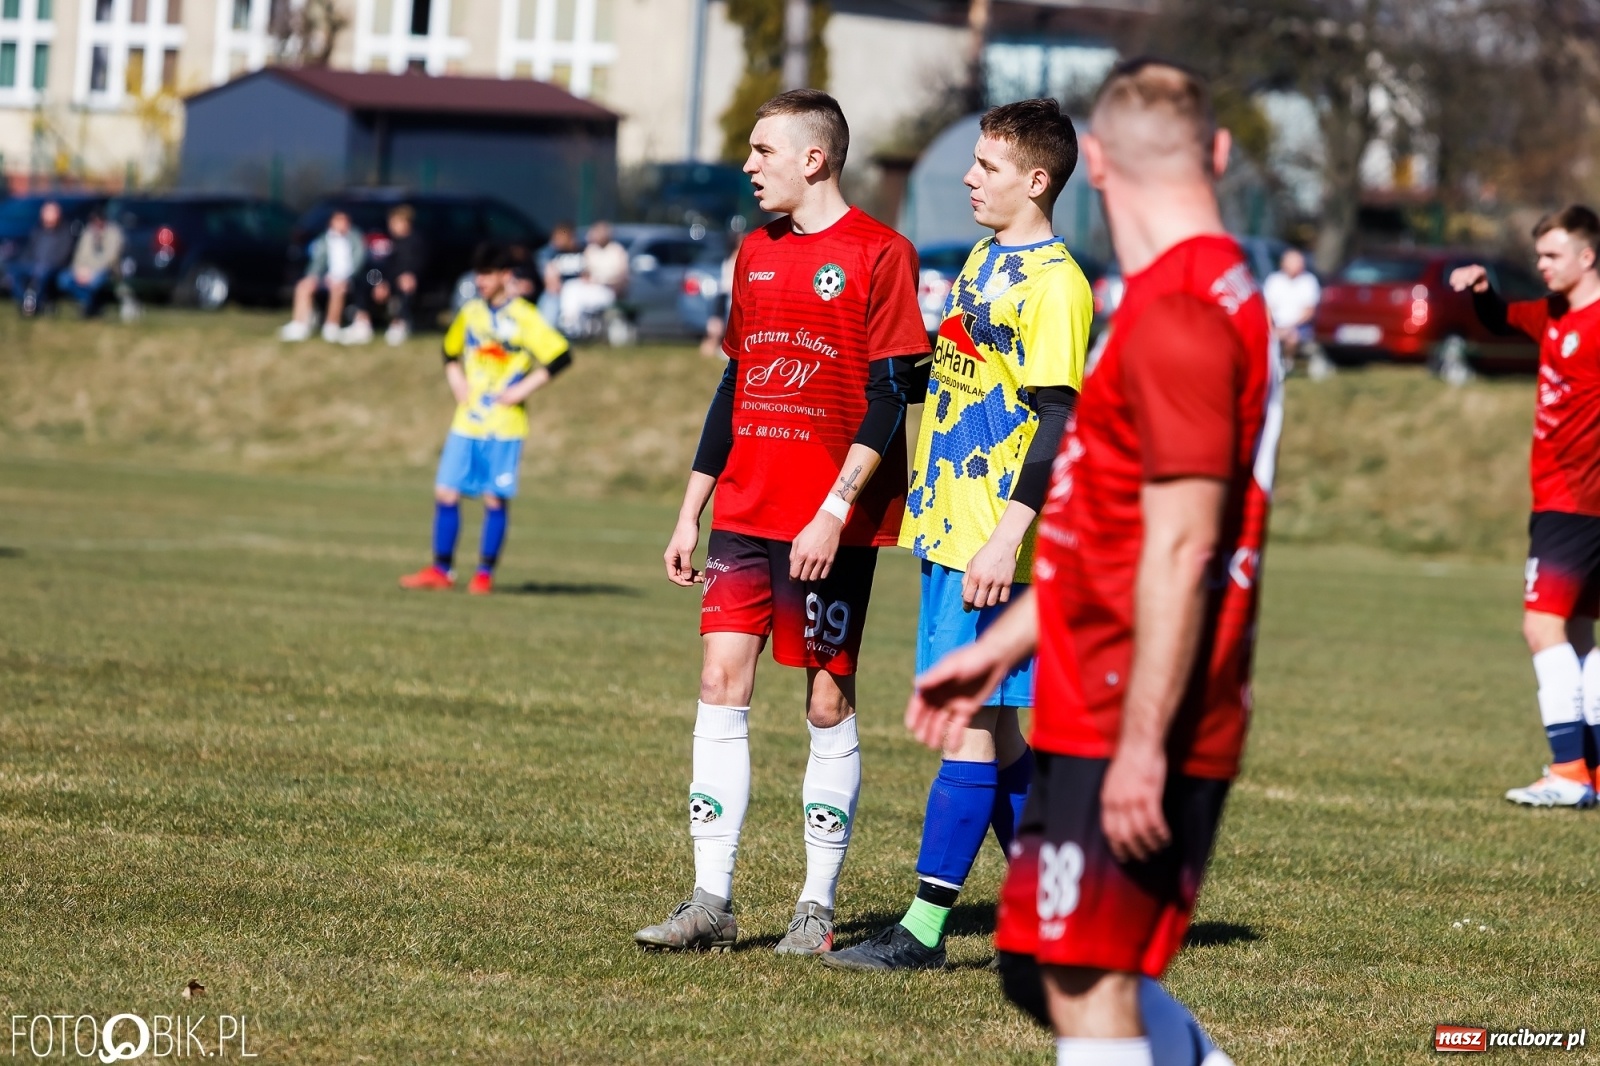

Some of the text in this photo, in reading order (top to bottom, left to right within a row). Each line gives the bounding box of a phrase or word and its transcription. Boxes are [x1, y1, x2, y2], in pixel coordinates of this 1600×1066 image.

[792, 327, 839, 359] Ślubne
[737, 423, 753, 436] tel.
[769, 426, 791, 439] 056
[793, 429, 810, 441] 744
[804, 591, 850, 646] 99
